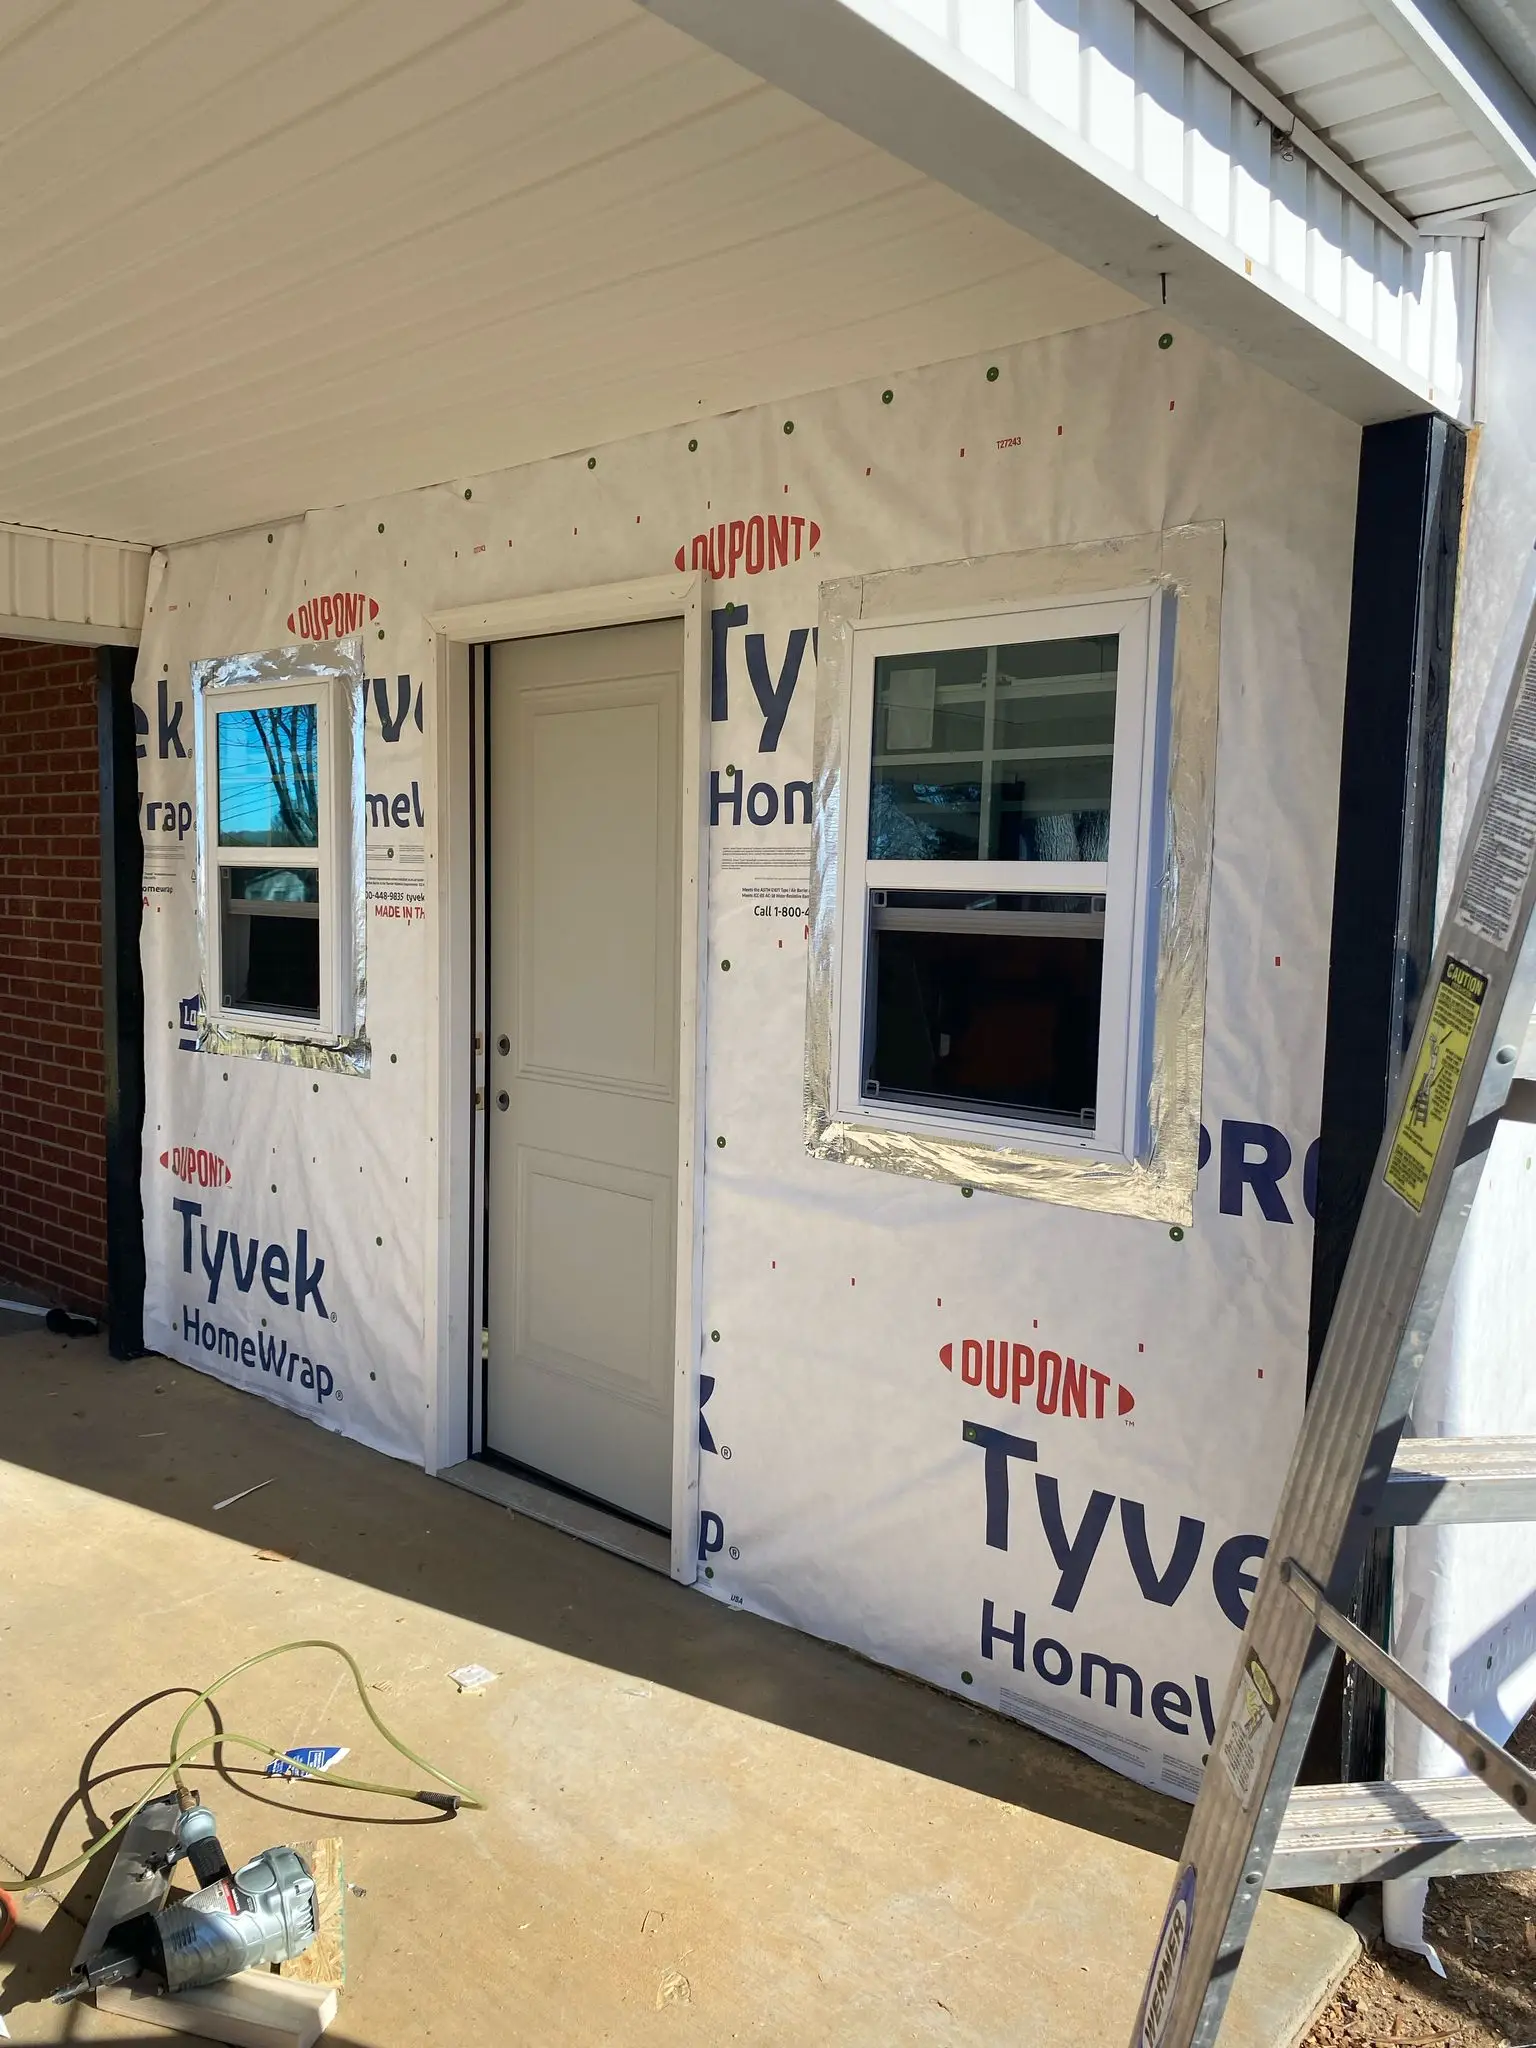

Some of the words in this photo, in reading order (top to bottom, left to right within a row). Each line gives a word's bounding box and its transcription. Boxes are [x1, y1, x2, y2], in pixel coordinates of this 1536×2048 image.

[996, 437, 1022, 449] T27243
[691, 515, 805, 580] DUPONT
[298, 592, 366, 641] DUPONT
[711, 604, 818, 752] Ty
[138, 791, 193, 841] rap
[375, 905, 400, 918] MADE
[402, 906, 413, 919] IN
[754, 905, 772, 917] Call
[1446, 962, 1484, 997] CAUTION
[172, 1146, 225, 1188] DUPONT
[173, 1196, 329, 1320] Tyvek
[183, 1304, 334, 1404] HomeWrap
[961, 1338, 1112, 1420] DUPONT
[962, 1419, 1271, 1632] Tyve
[730, 1593, 744, 1605] USA
